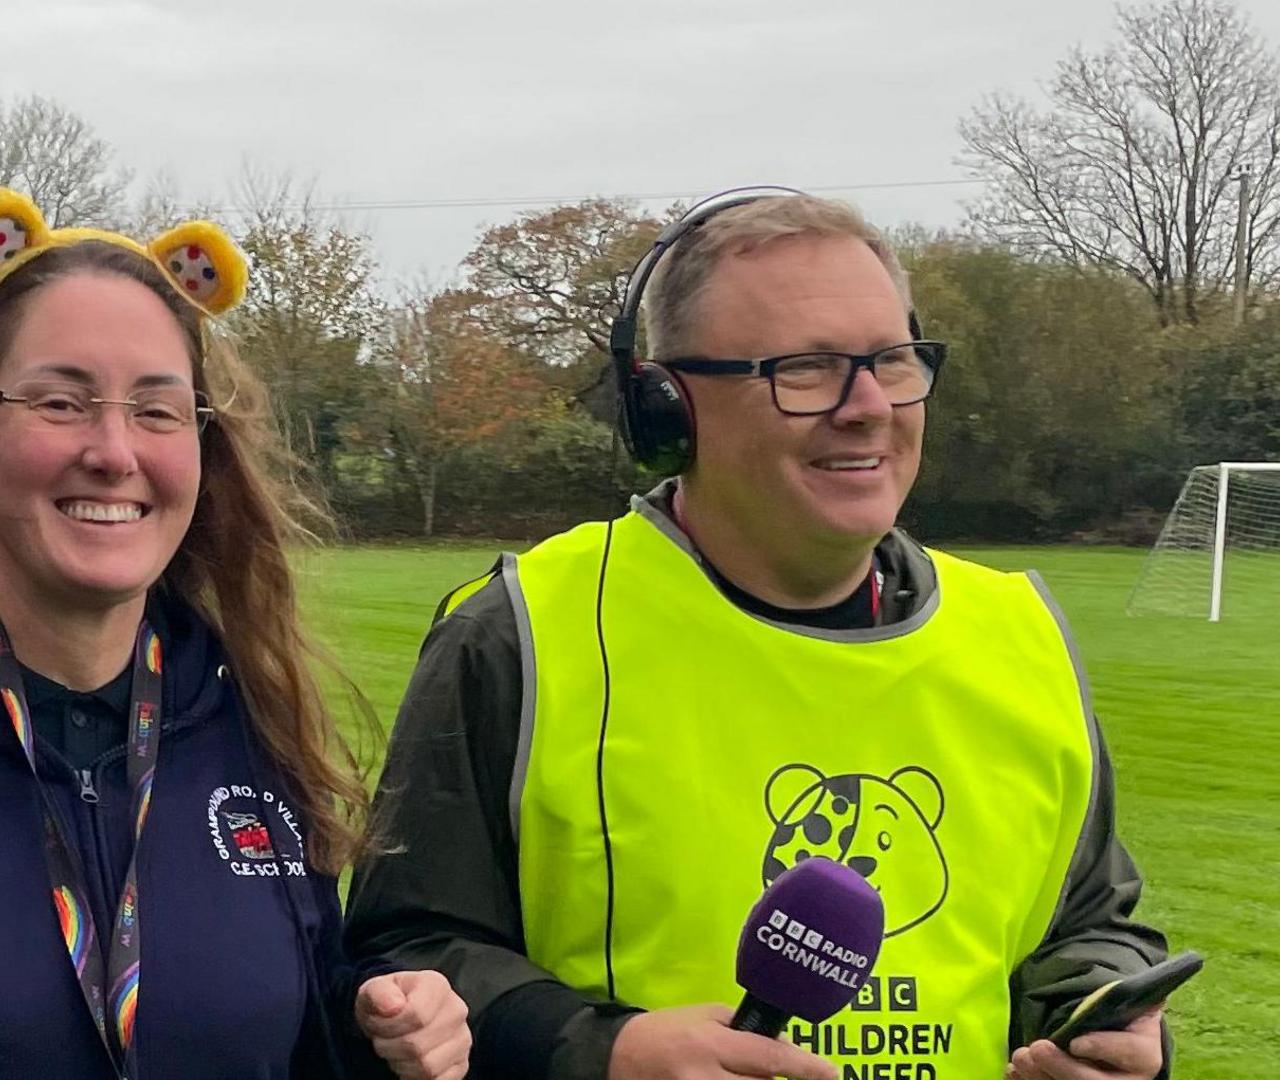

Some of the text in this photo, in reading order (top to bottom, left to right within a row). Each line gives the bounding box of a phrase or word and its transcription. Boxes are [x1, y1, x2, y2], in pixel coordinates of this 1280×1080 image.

[230, 785, 274, 802] ROD
[769, 911, 868, 969] BBC RADIO
[756, 925, 860, 989] CORNWALL
[854, 979, 915, 1010] BC
[790, 1023, 954, 1056] HILDREN
